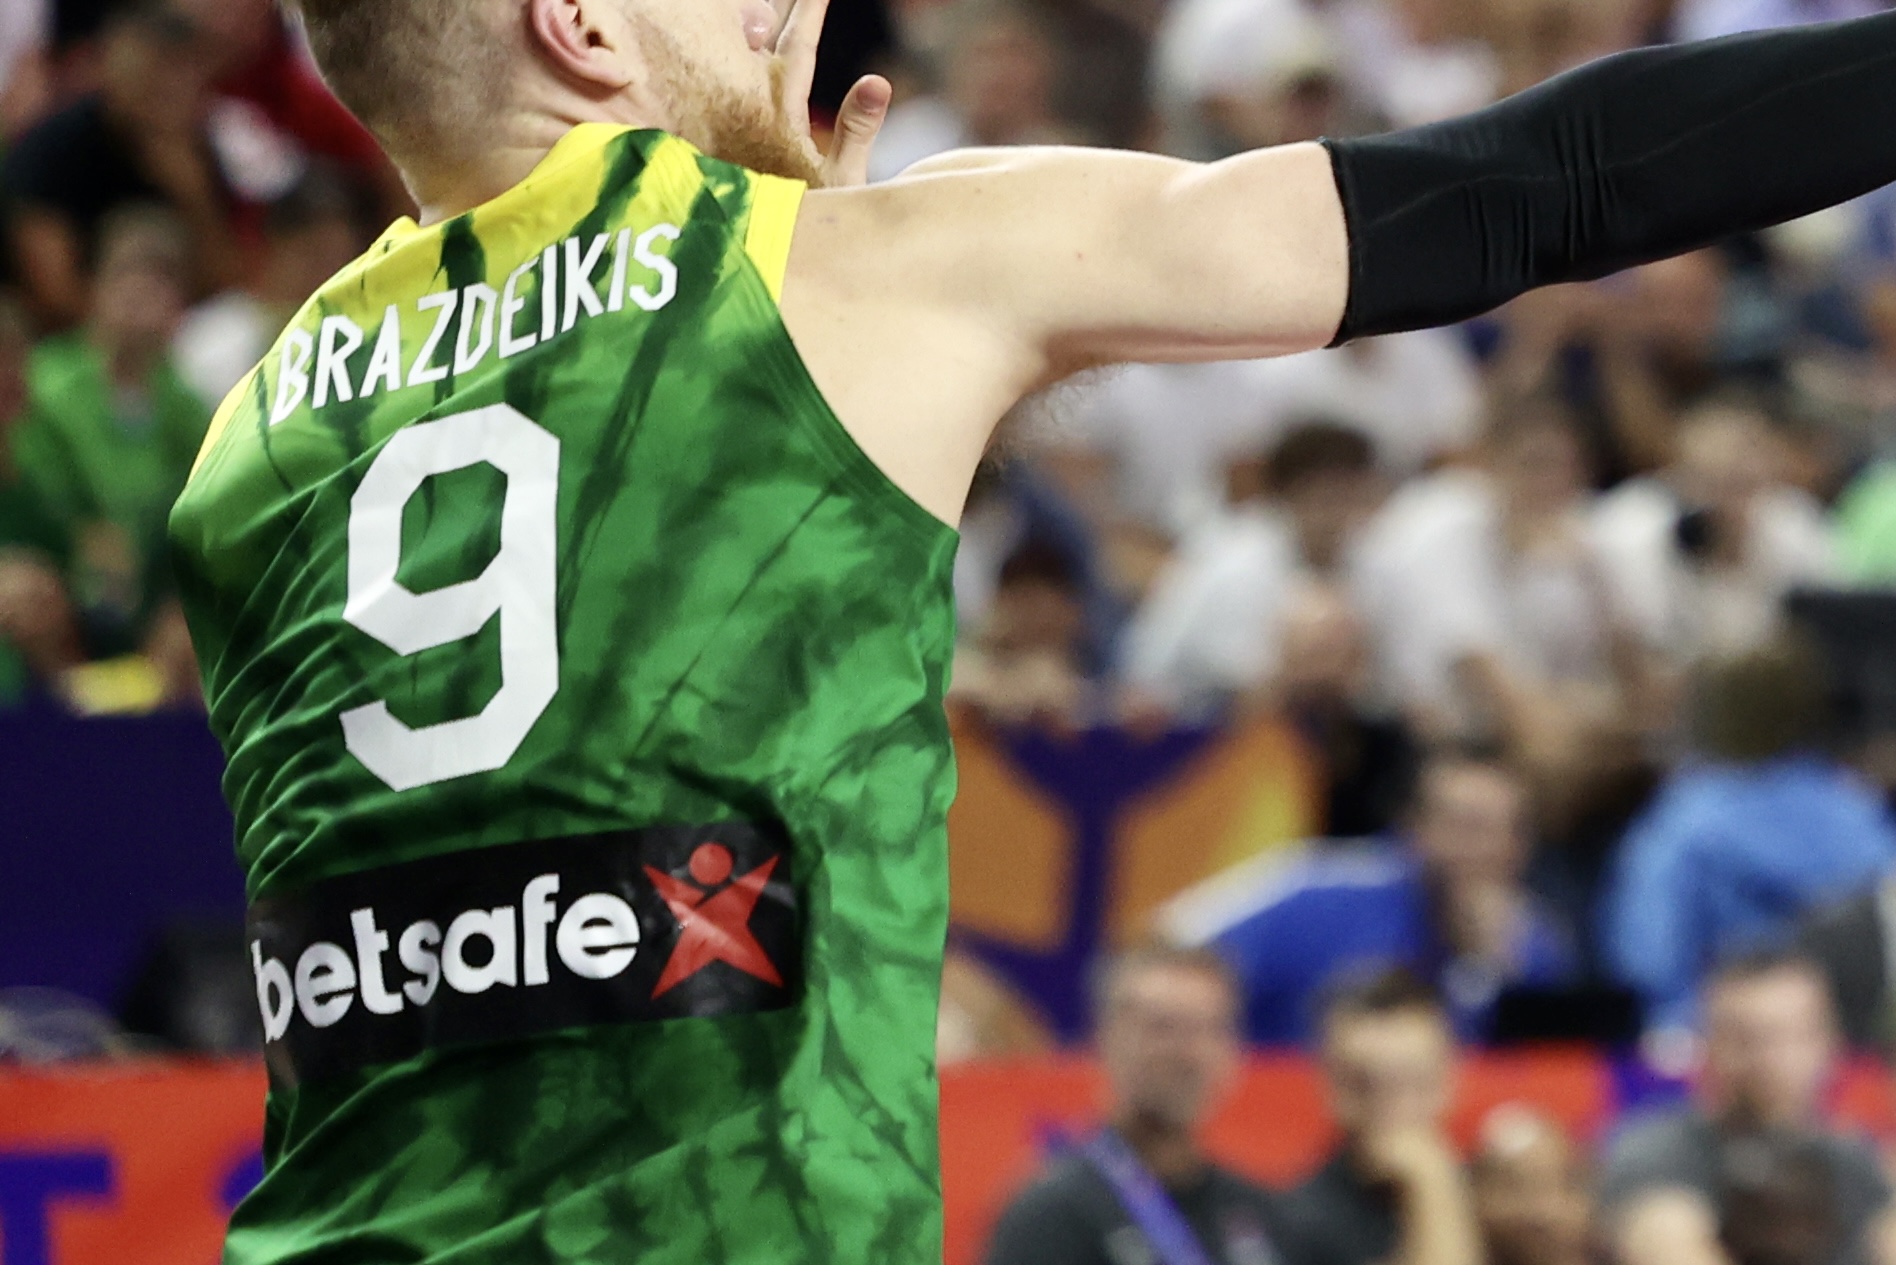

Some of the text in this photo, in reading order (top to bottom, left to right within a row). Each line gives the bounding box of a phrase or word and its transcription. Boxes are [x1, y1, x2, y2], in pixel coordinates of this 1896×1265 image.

[269, 223, 681, 426] BRAZDEIKIS
[340, 403, 561, 792] 9
[251, 873, 640, 1044] betsafe
